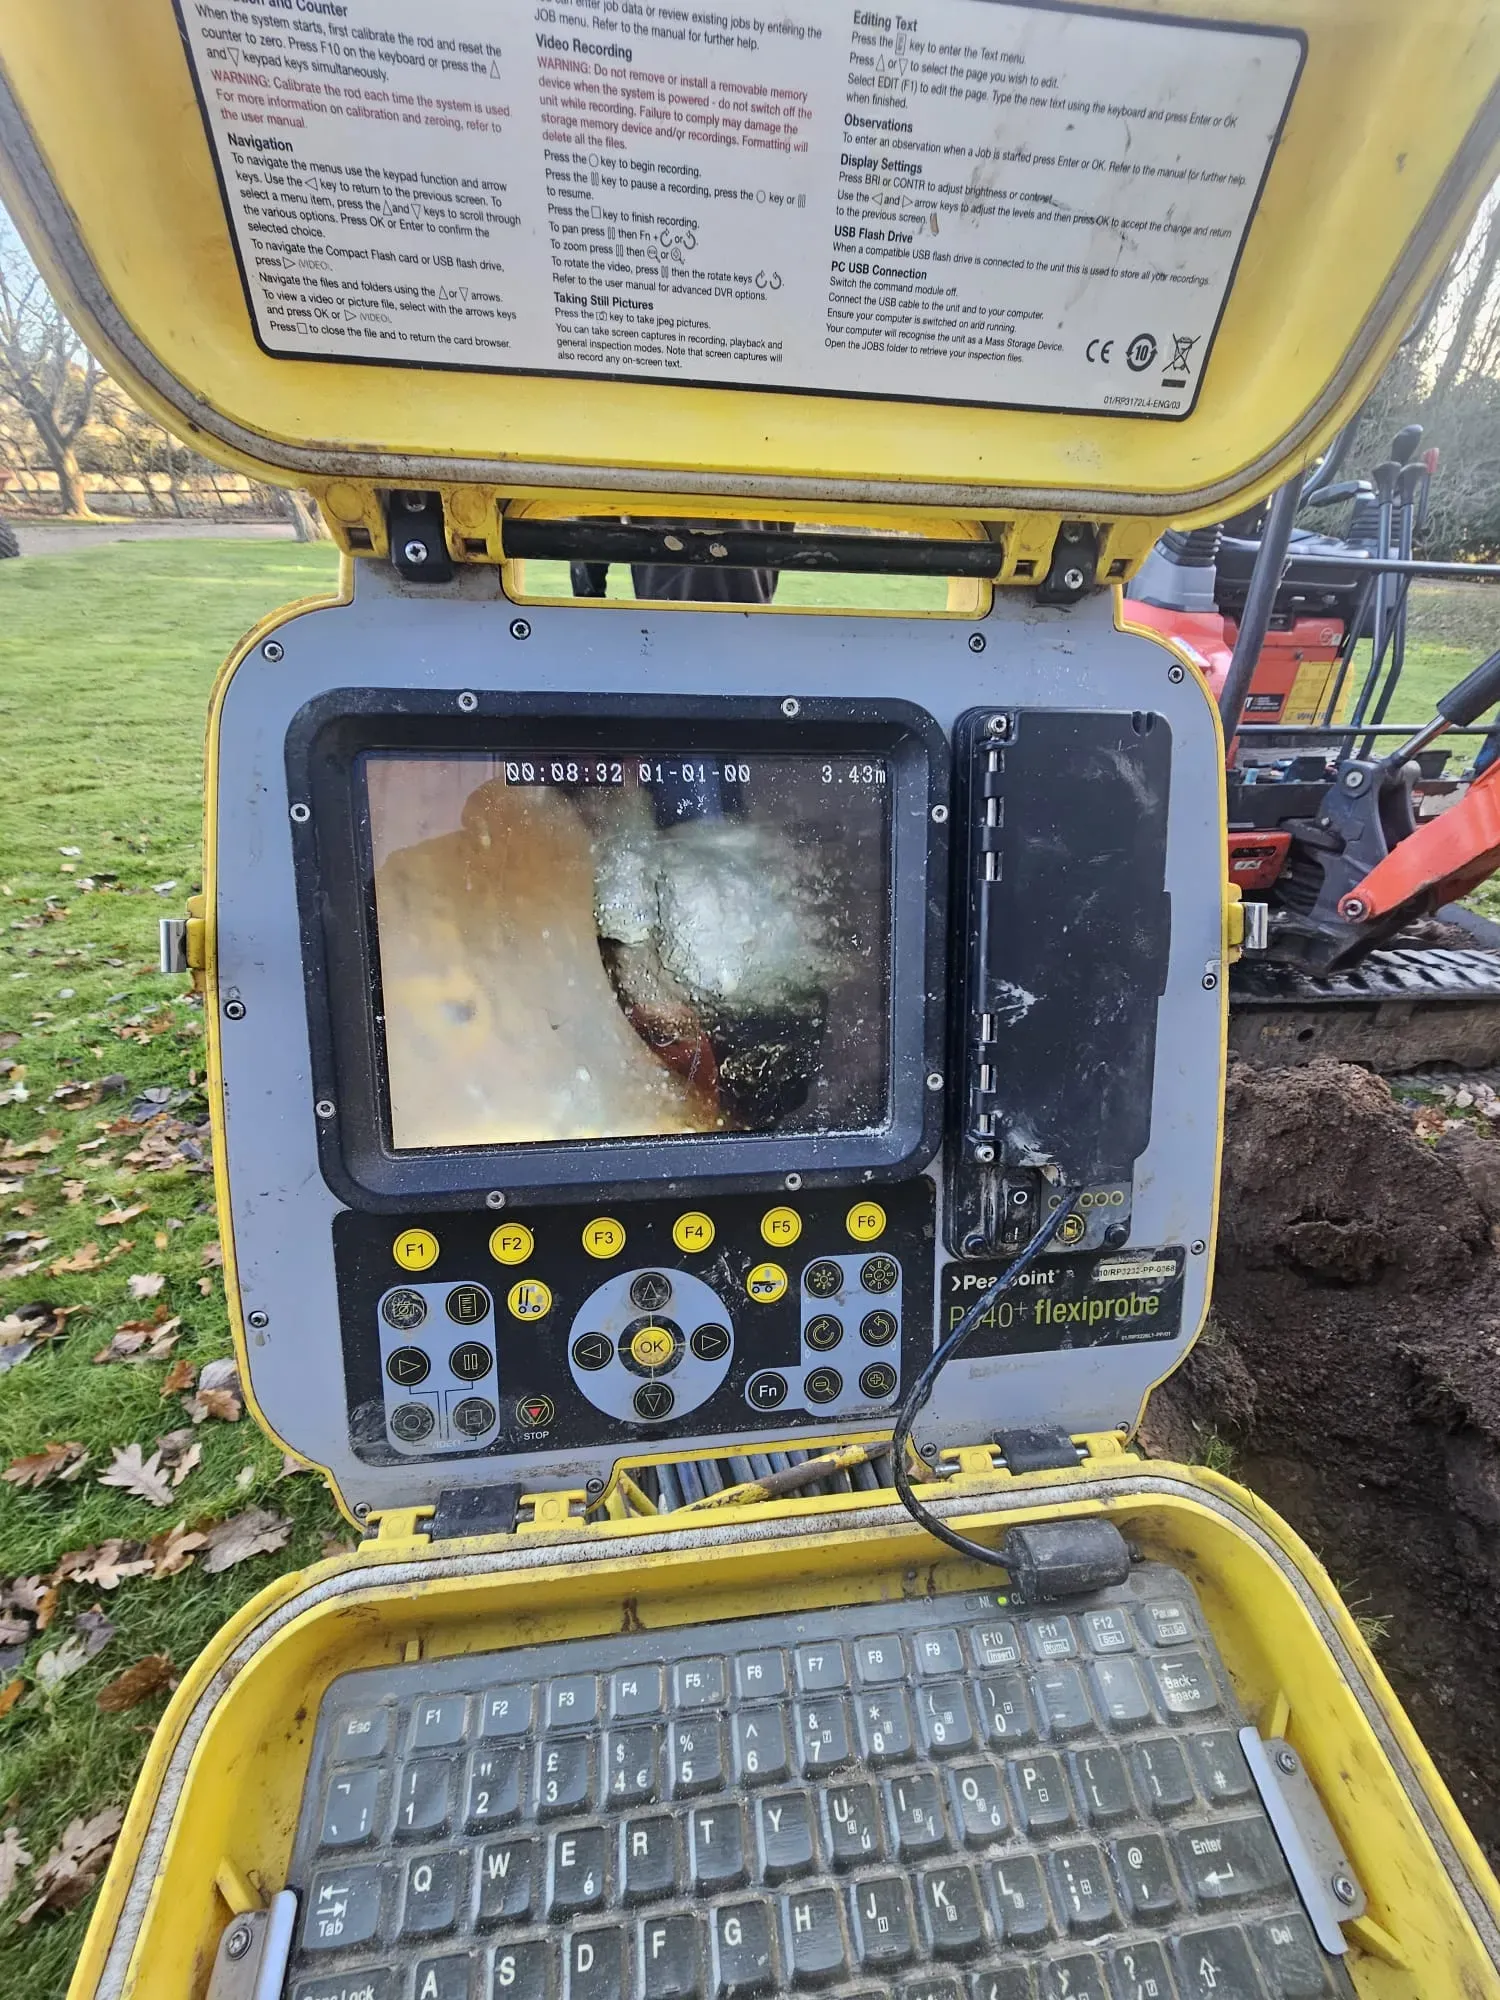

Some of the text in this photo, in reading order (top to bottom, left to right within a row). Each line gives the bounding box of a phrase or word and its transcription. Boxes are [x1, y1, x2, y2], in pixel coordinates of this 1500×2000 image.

[269, 0, 292, 9] and
[296, 2, 347, 17] Counter
[533, 7, 761, 52] JOB menu. Refer to the manual for further help.
[852, 9, 918, 33] Editing Text
[534, 32, 633, 63] Video Recording
[845, 90, 909, 109] when finished.
[843, 111, 913, 134] Observations
[226, 131, 294, 153] Navigation
[839, 152, 923, 177] Display Settings
[545, 184, 595, 200] to resume.
[246, 220, 327, 238] selected choice.
[833, 223, 914, 244] USB Flash Drive
[249, 237, 505, 273] To navigate the Compact Flash card or USB flash drive,
[830, 259, 928, 280] PC USB Connection
[828, 275, 959, 297] Switch the command module off.
[552, 290, 654, 311] Taking Still Pictures
[827, 291, 1045, 320] Connect the USB cable to the unit and to your computer.
[268, 319, 512, 348] Press to close the file and to return the card browser.
[556, 347, 684, 369] also record any on-screen text.
[1135, 345, 1149, 361] 10
[506, 763, 886, 784] 00:08:32 01-01-00 3.43m
[772, 1221, 791, 1234] F5
[857, 1215, 876, 1228] F6
[594, 1232, 614, 1245] F3
[685, 1226, 703, 1239] F4
[406, 1243, 424, 1257] F1
[502, 1237, 522, 1251] F2
[963, 1269, 1055, 1291] Peaoint
[1034, 1292, 1159, 1326] flexiprobe
[640, 1340, 664, 1354] OK
[759, 1385, 777, 1397] Fn
[523, 1431, 550, 1441] STOP
[979, 1597, 993, 1609] NL
[1011, 1594, 1025, 1605] CL
[1038, 1624, 1058, 1638] F11
[1092, 1616, 1113, 1631] F12
[926, 1643, 941, 1656] F9
[982, 1632, 1003, 1647] F10
[809, 1657, 824, 1672] F7
[868, 1651, 883, 1664] F8
[685, 1674, 701, 1688] F5
[747, 1665, 763, 1679] F6
[559, 1692, 575, 1706] F3
[622, 1682, 637, 1697] F4
[425, 1709, 441, 1725] F1
[492, 1701, 508, 1716] F2
[347, 1720, 371, 1734] Esc
[935, 1722, 946, 1742] 9
[995, 1715, 1006, 1733] 0
[811, 1741, 821, 1762] 7
[873, 1732, 884, 1753] 8
[682, 1761, 693, 1782] 5
[747, 1751, 758, 1771] 6
[614, 1770, 625, 1792] 4
[962, 1778, 978, 1800] O
[1023, 1768, 1036, 1791] P
[546, 1781, 558, 1802] 3
[406, 1802, 414, 1825] 1
[476, 1792, 488, 1814] 2
[833, 1798, 848, 1823] U
[768, 1809, 782, 1832] Y
[700, 1820, 714, 1844] T
[561, 1841, 576, 1866] E
[633, 1832, 648, 1856] R
[1192, 1837, 1223, 1855] Enter
[488, 1853, 510, 1879] W
[414, 1866, 432, 1892] Q
[998, 1870, 1014, 1896] L
[932, 1881, 949, 1907] K
[867, 1893, 876, 1919] J
[319, 1920, 344, 1937] Tab
[795, 1907, 812, 1931] H
[724, 1918, 742, 1946] G
[1271, 1927, 1292, 1945] Del
[653, 1931, 666, 1959] F
[577, 1944, 594, 1972] D
[499, 1956, 516, 1986] S
[421, 1971, 438, 2000] A
